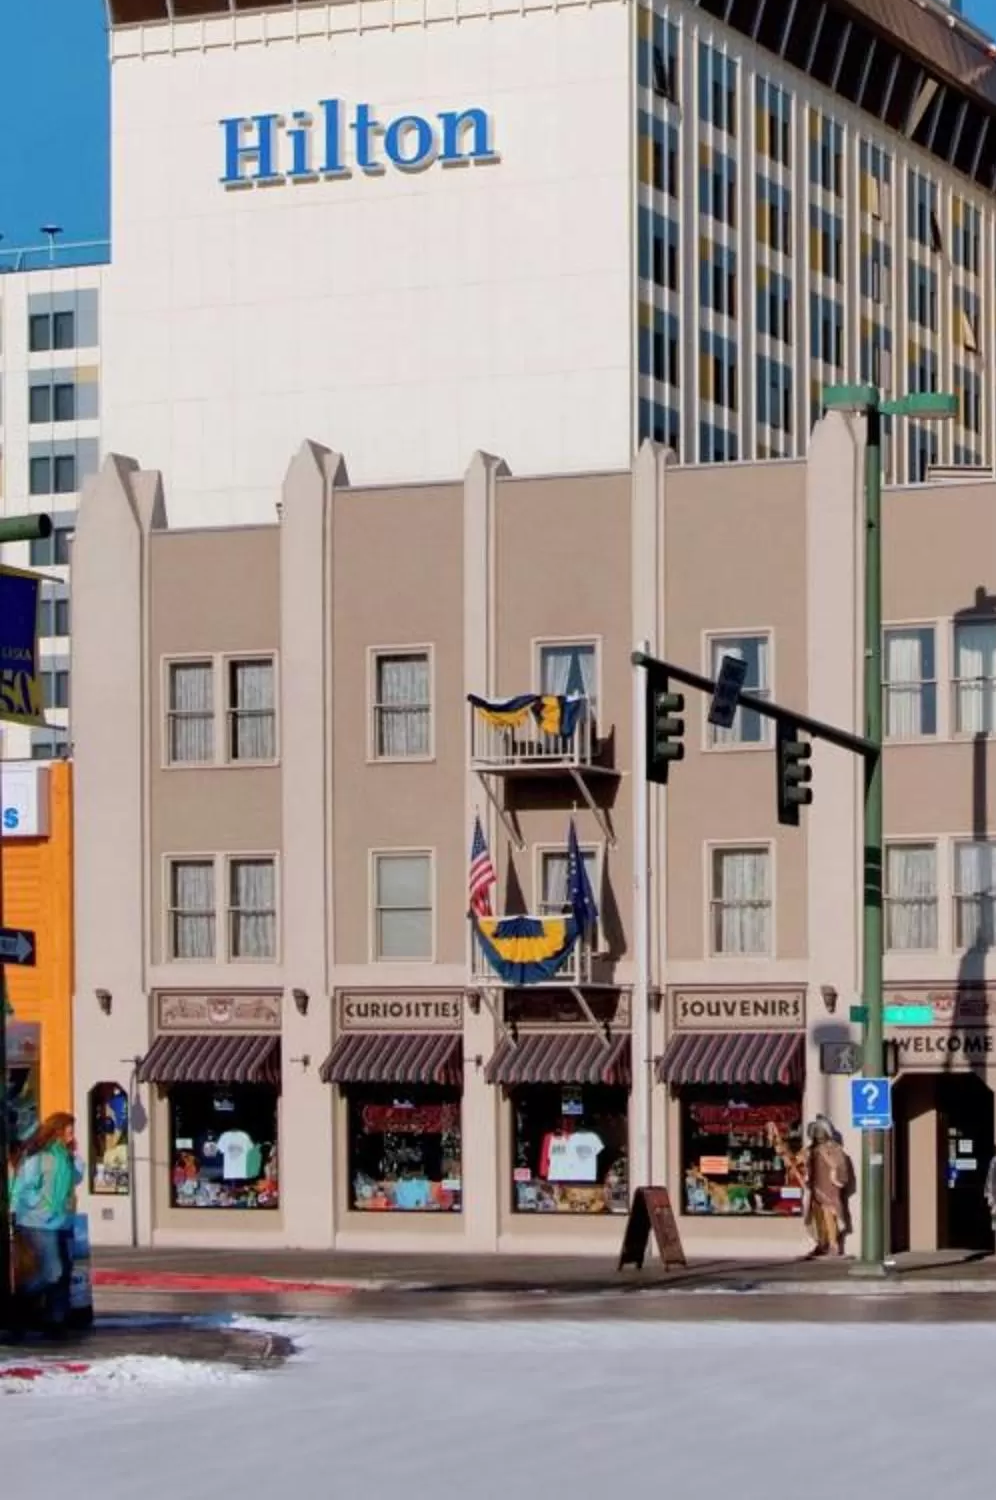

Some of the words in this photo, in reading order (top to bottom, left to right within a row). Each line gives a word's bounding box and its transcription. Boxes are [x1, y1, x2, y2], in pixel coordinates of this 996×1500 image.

[218, 98, 498, 186] Hilton
[345, 1001, 460, 1019] CURIOSITIES
[680, 1000, 801, 1018] SOUVENIRS
[891, 1035, 994, 1053] WELCOME
